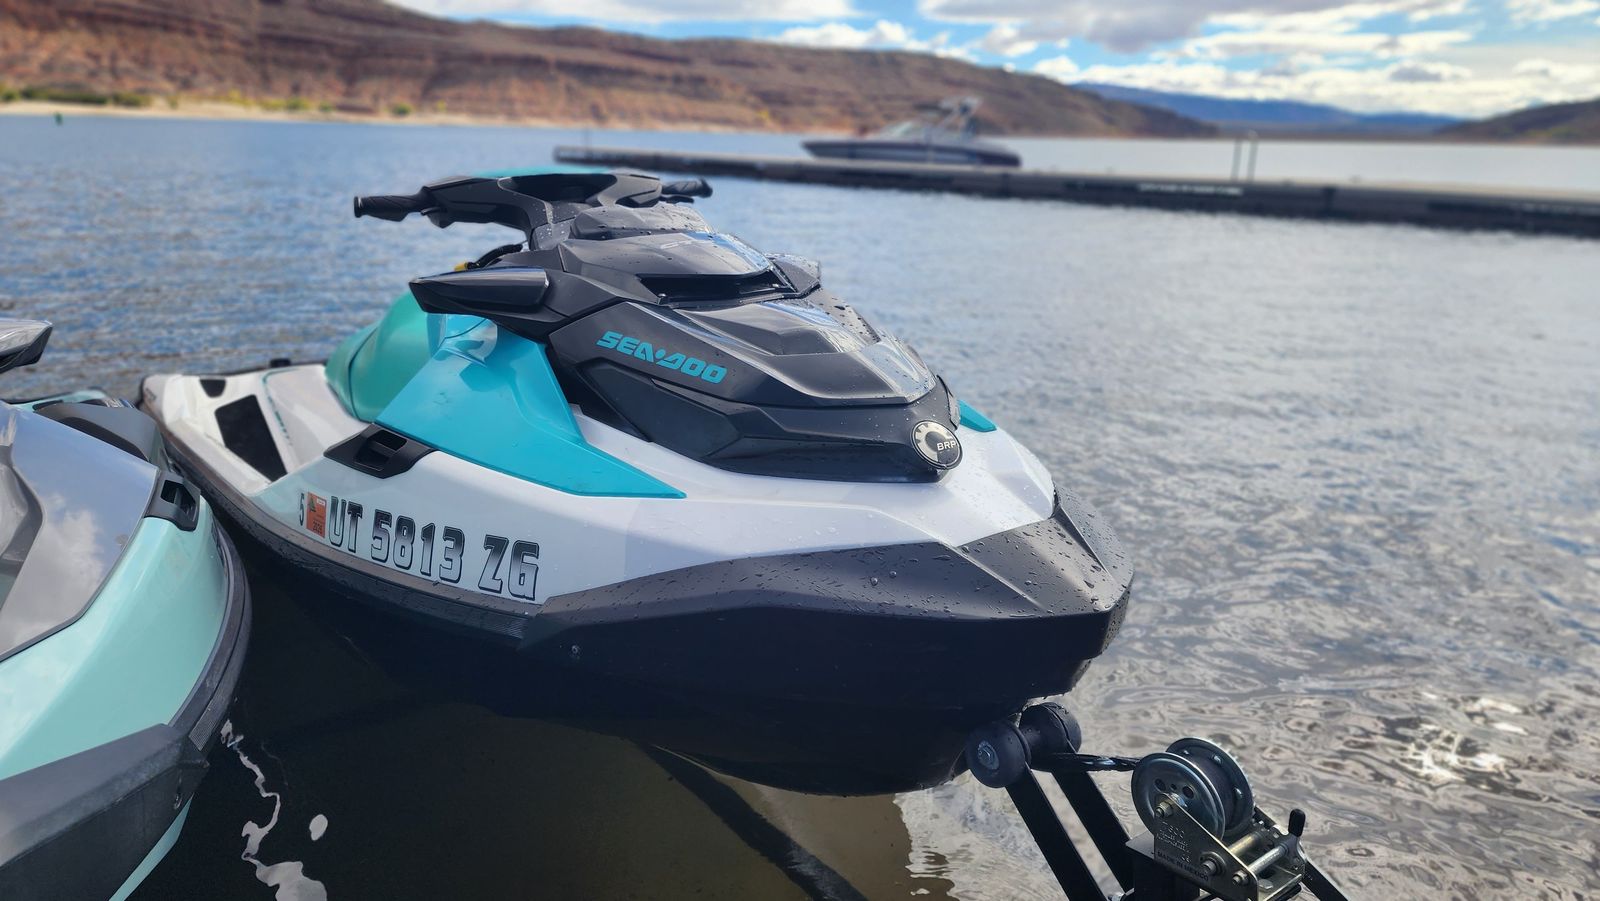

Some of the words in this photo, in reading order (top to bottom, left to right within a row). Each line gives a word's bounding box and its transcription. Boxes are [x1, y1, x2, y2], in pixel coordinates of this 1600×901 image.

[936, 440, 956, 451] BRP
[328, 496, 363, 554] UT
[370, 509, 465, 584] 5813
